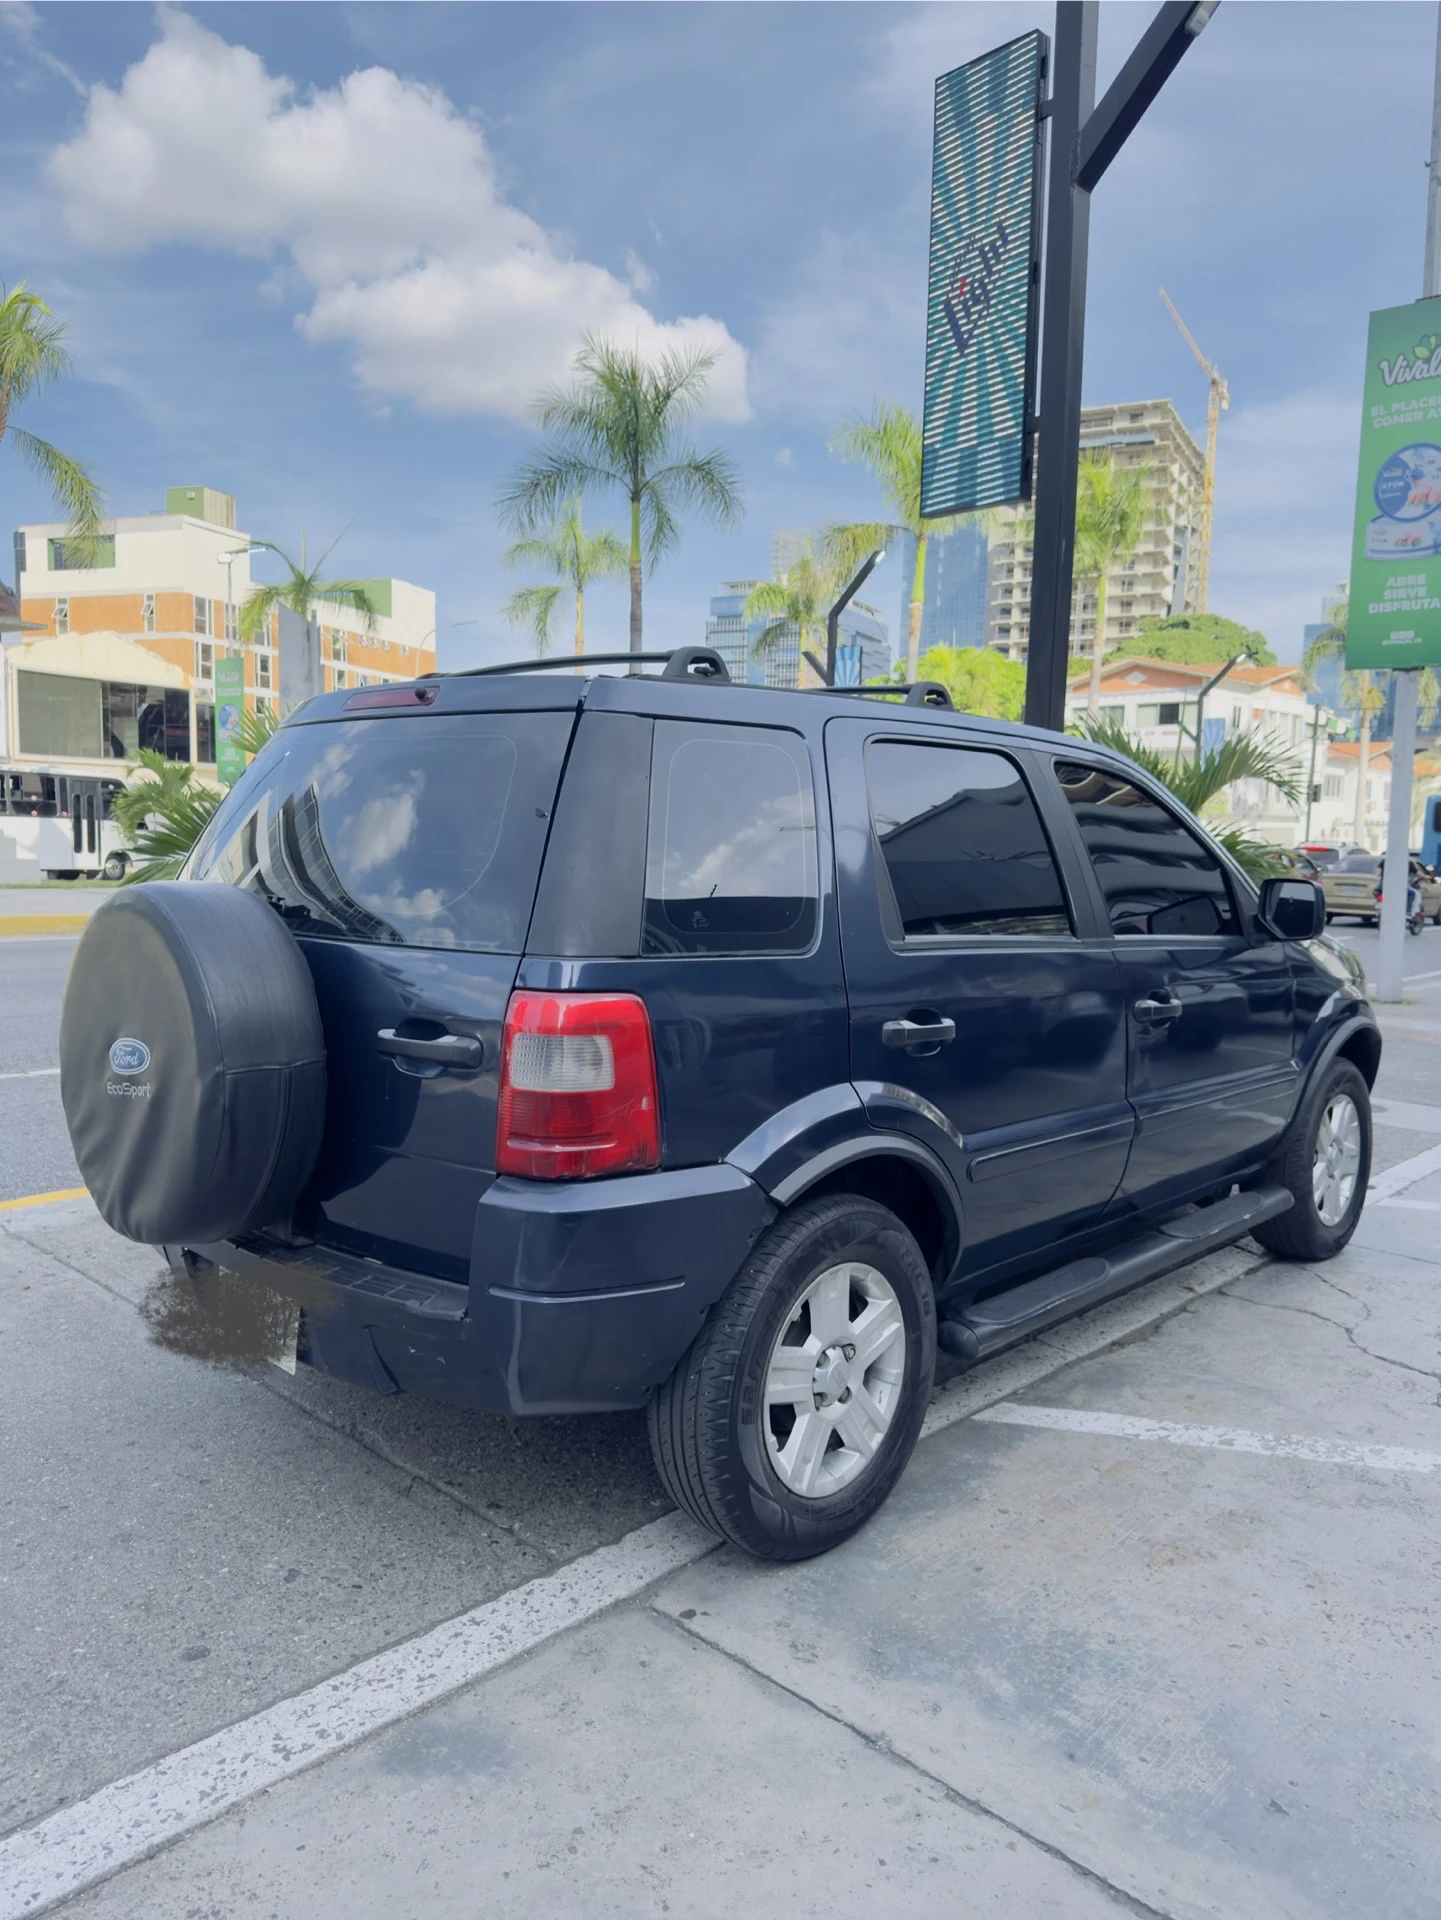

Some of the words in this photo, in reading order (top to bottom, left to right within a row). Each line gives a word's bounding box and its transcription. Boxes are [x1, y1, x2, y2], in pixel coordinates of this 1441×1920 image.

[1379, 346, 1441, 386] Vival
[1371, 404, 1387, 416] EL
[1373, 410, 1423, 428] COMER
[1385, 573, 1427, 587] ABRE
[1383, 586, 1427, 600] SIRVE
[114, 1045, 139, 1065] Ford
[106, 1081, 151, 1099] EcoSport
